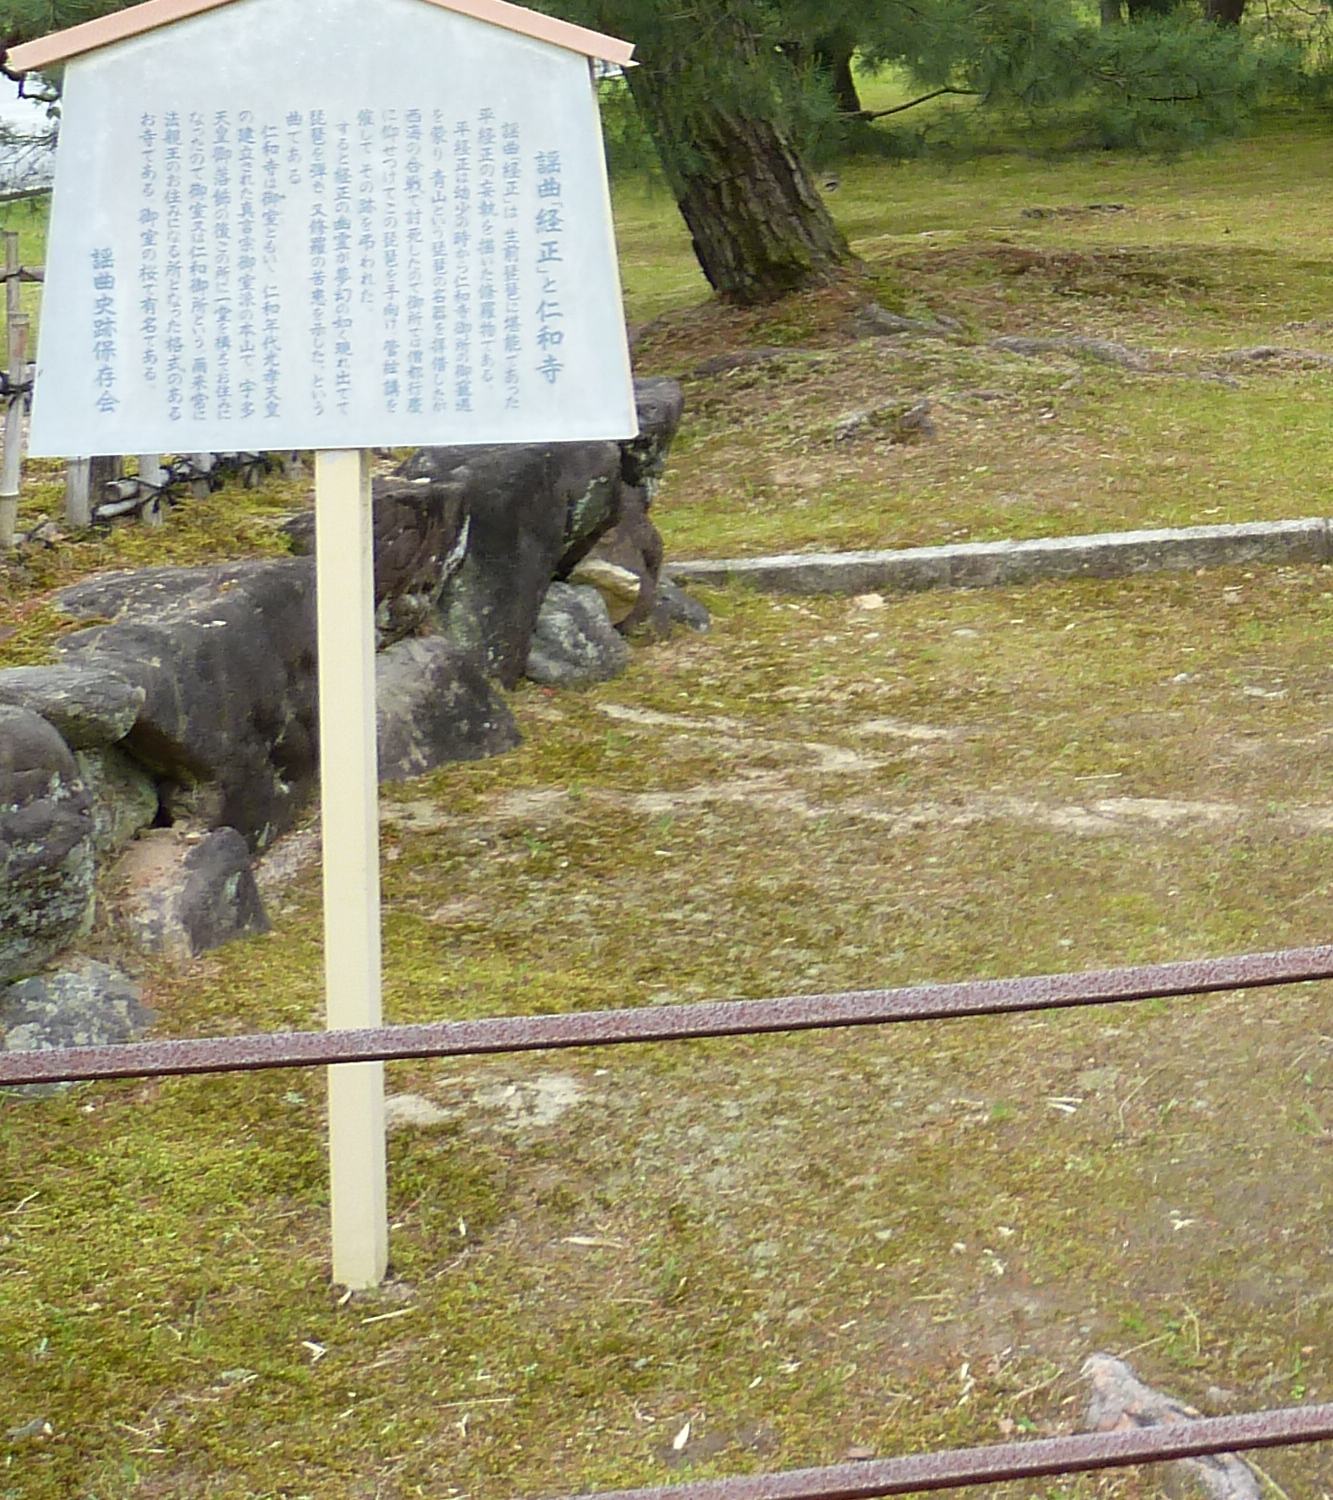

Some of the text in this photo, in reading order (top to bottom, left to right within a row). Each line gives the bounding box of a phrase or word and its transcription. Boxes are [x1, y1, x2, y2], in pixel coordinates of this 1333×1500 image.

[91, 247, 121, 413] 謡曲史跡保存会
[535, 150, 564, 385] 謡曲「経正」と仁和寺
